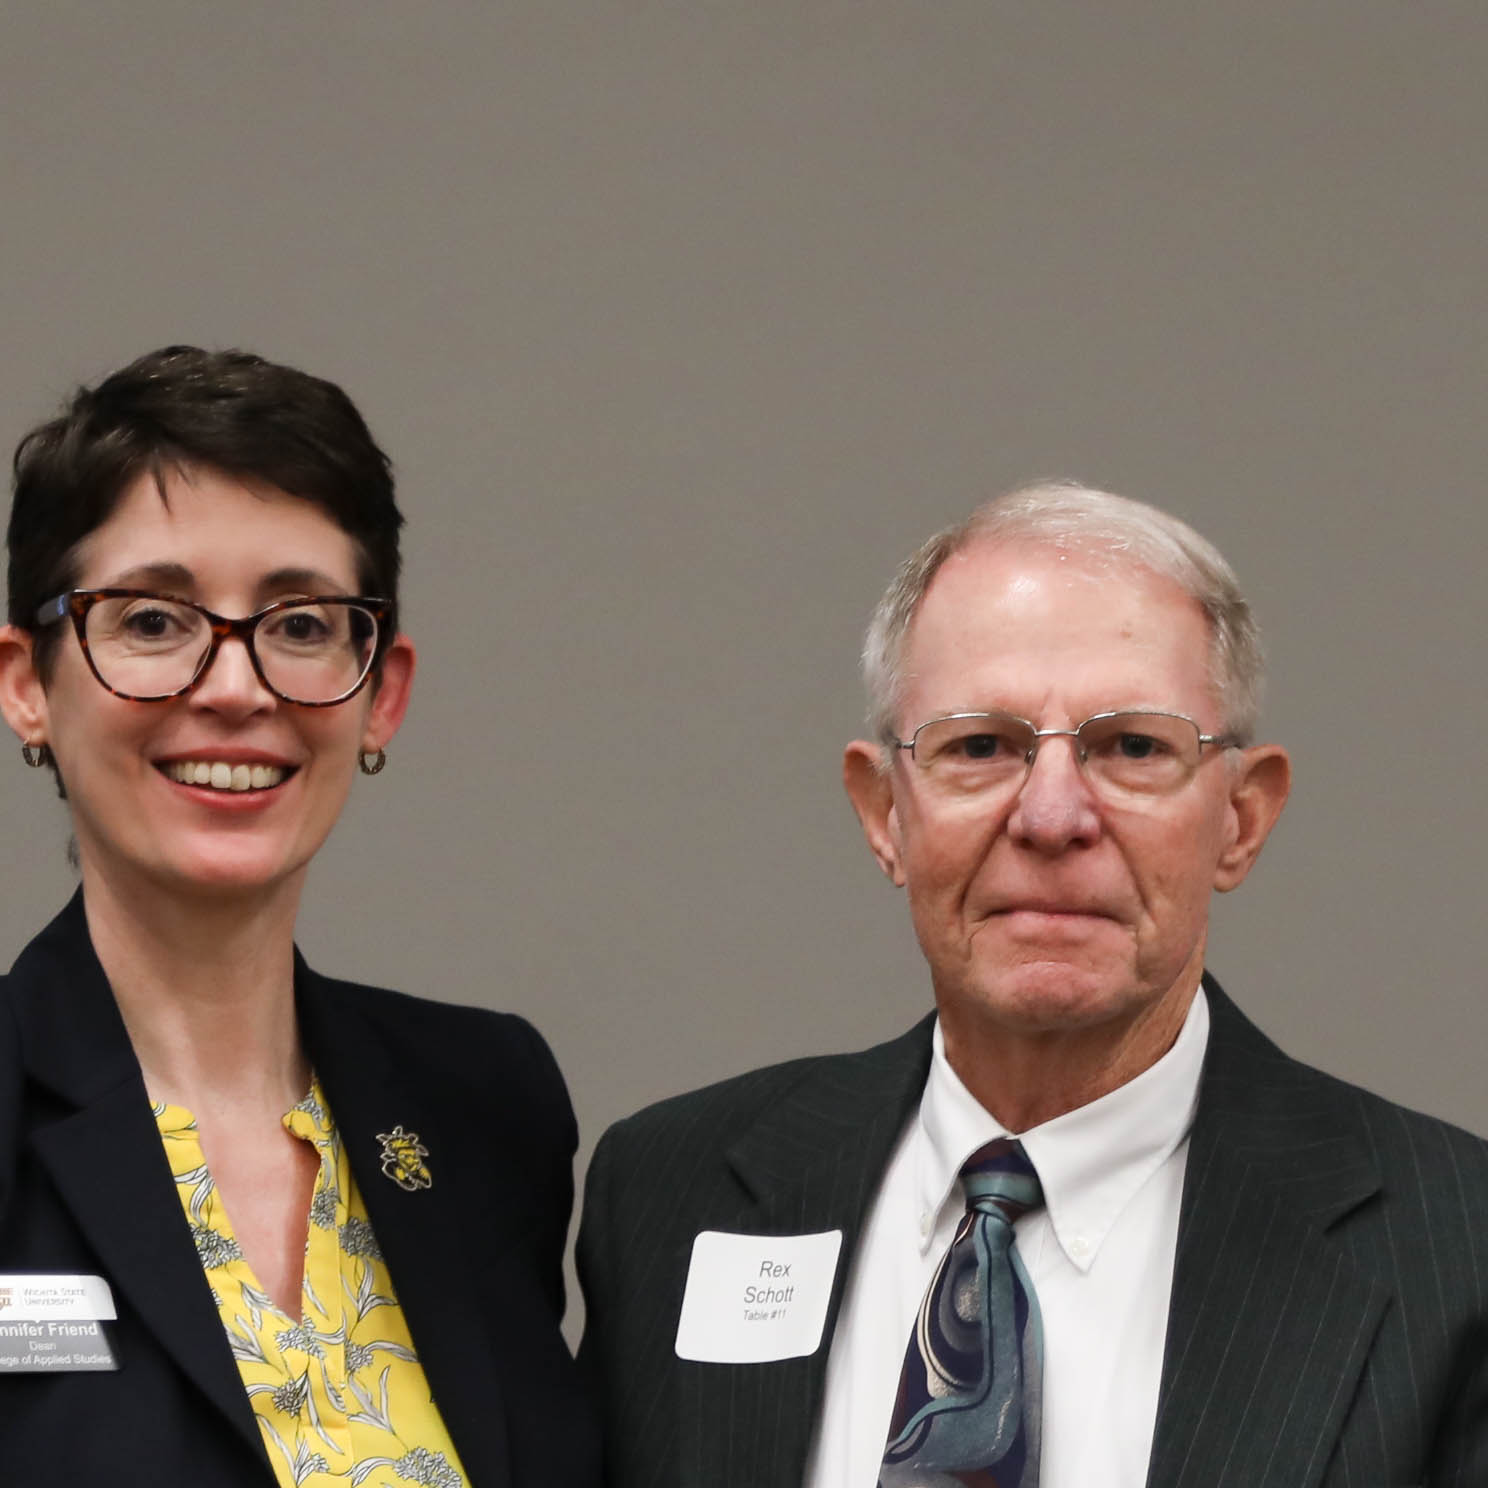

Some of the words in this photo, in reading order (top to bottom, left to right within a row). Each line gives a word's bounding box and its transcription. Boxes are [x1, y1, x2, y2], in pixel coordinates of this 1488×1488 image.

[759, 1261, 792, 1278] Rex
[744, 1285, 794, 1304] Schott
[743, 1309, 769, 1321] Table
[48, 1322, 98, 1337] Friend
[28, 1340, 57, 1351] Dean
[21, 1354, 31, 1365] of
[33, 1354, 71, 1366] Applied
[73, 1353, 112, 1365] Studies
